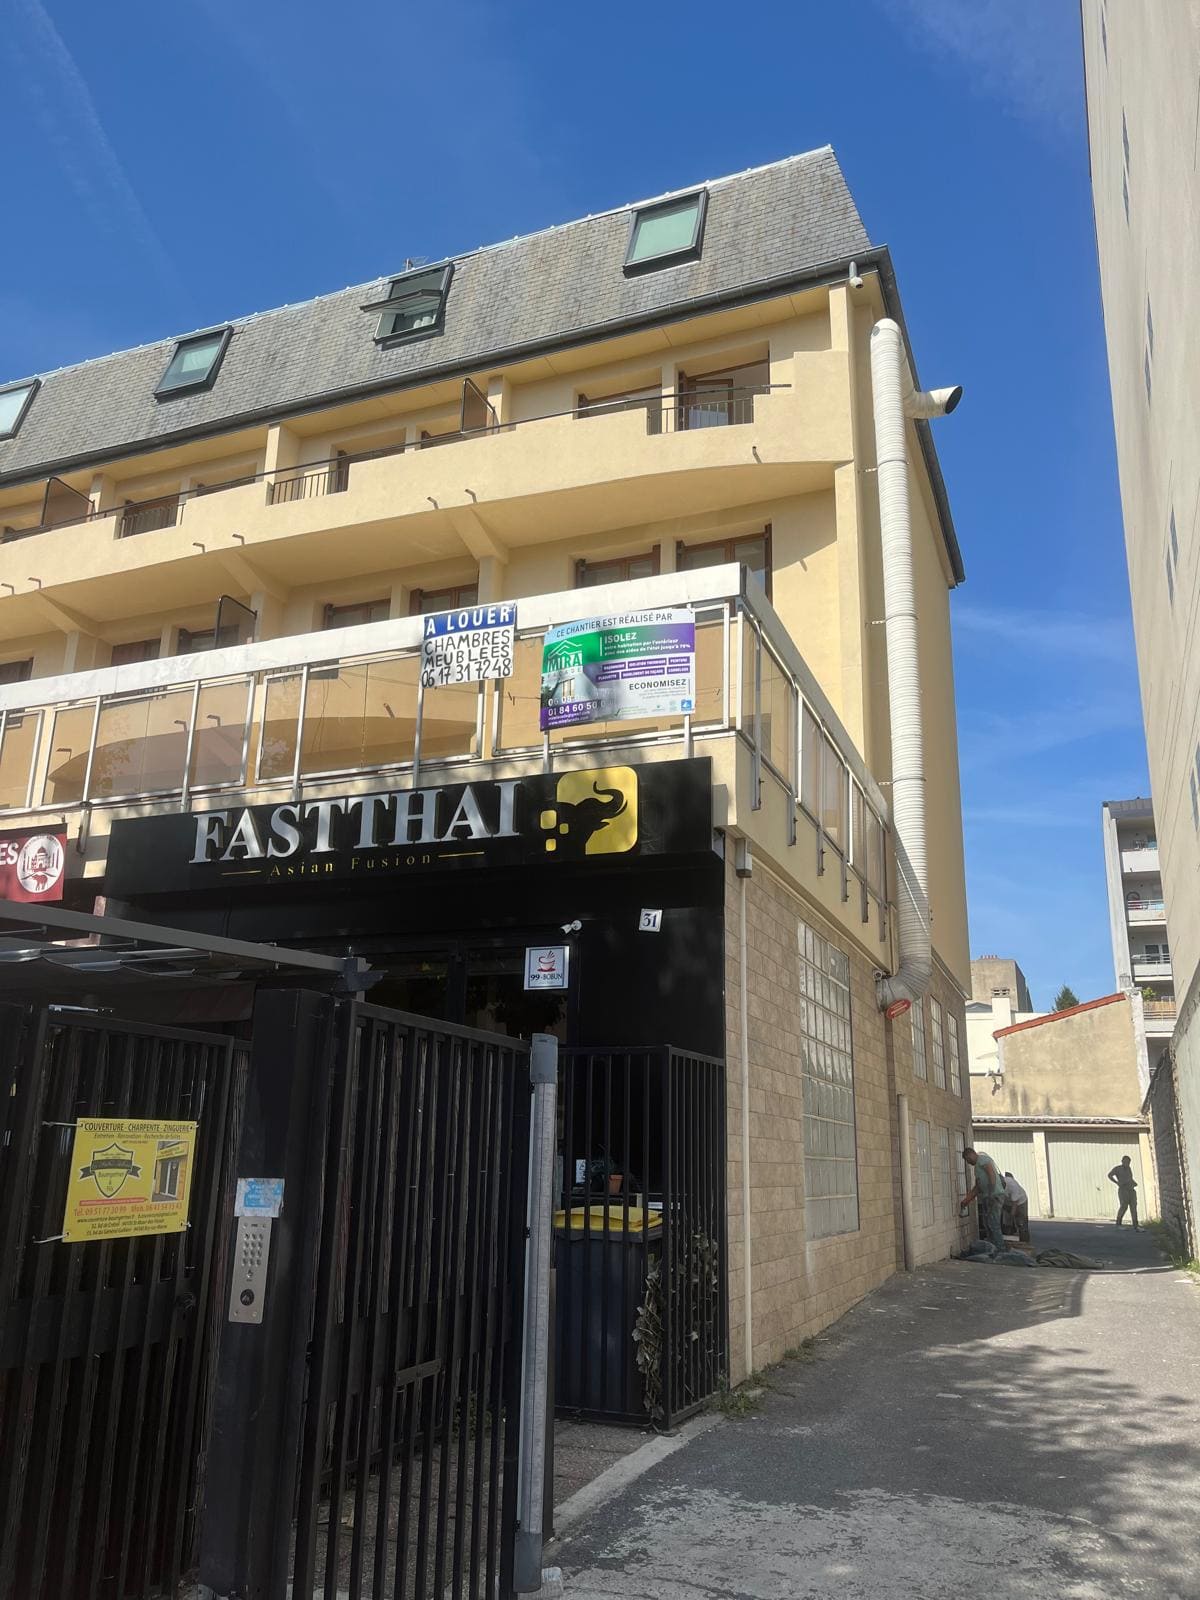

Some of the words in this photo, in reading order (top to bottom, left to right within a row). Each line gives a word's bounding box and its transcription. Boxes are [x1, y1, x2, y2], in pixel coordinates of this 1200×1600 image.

[426, 618, 436, 636] A
[447, 606, 510, 631] LOUER
[556, 630, 566, 638] CE
[566, 620, 601, 635] CHANTIER
[603, 618, 617, 627] EST
[619, 613, 653, 625] RÉALISÉ
[656, 613, 673, 621] PAR
[424, 629, 510, 655] CHAMBRES
[604, 632, 637, 644] ISOLEZ
[424, 645, 510, 669] MEUBLEES
[548, 653, 582, 672] MIRA
[421, 669, 435, 688] 06
[438, 666, 451, 685] 17
[456, 663, 470, 681] 31
[629, 678, 687, 691] ECONOMISEZ
[548, 708, 557, 716] 01
[559, 706, 570, 714] 84
[572, 703, 583, 712] 60
[586, 701, 597, 710] 50
[189, 780, 522, 864] FASTTHAI
[270, 863, 335, 877] Asian
[351, 853, 431, 870] Fusion
[643, 913, 657, 928] 31
[84, 1122, 124, 1131] COUVERTURE
[128, 1123, 160, 1132] CHARPENTE
[163, 1124, 190, 1132] ZINGUERIE
